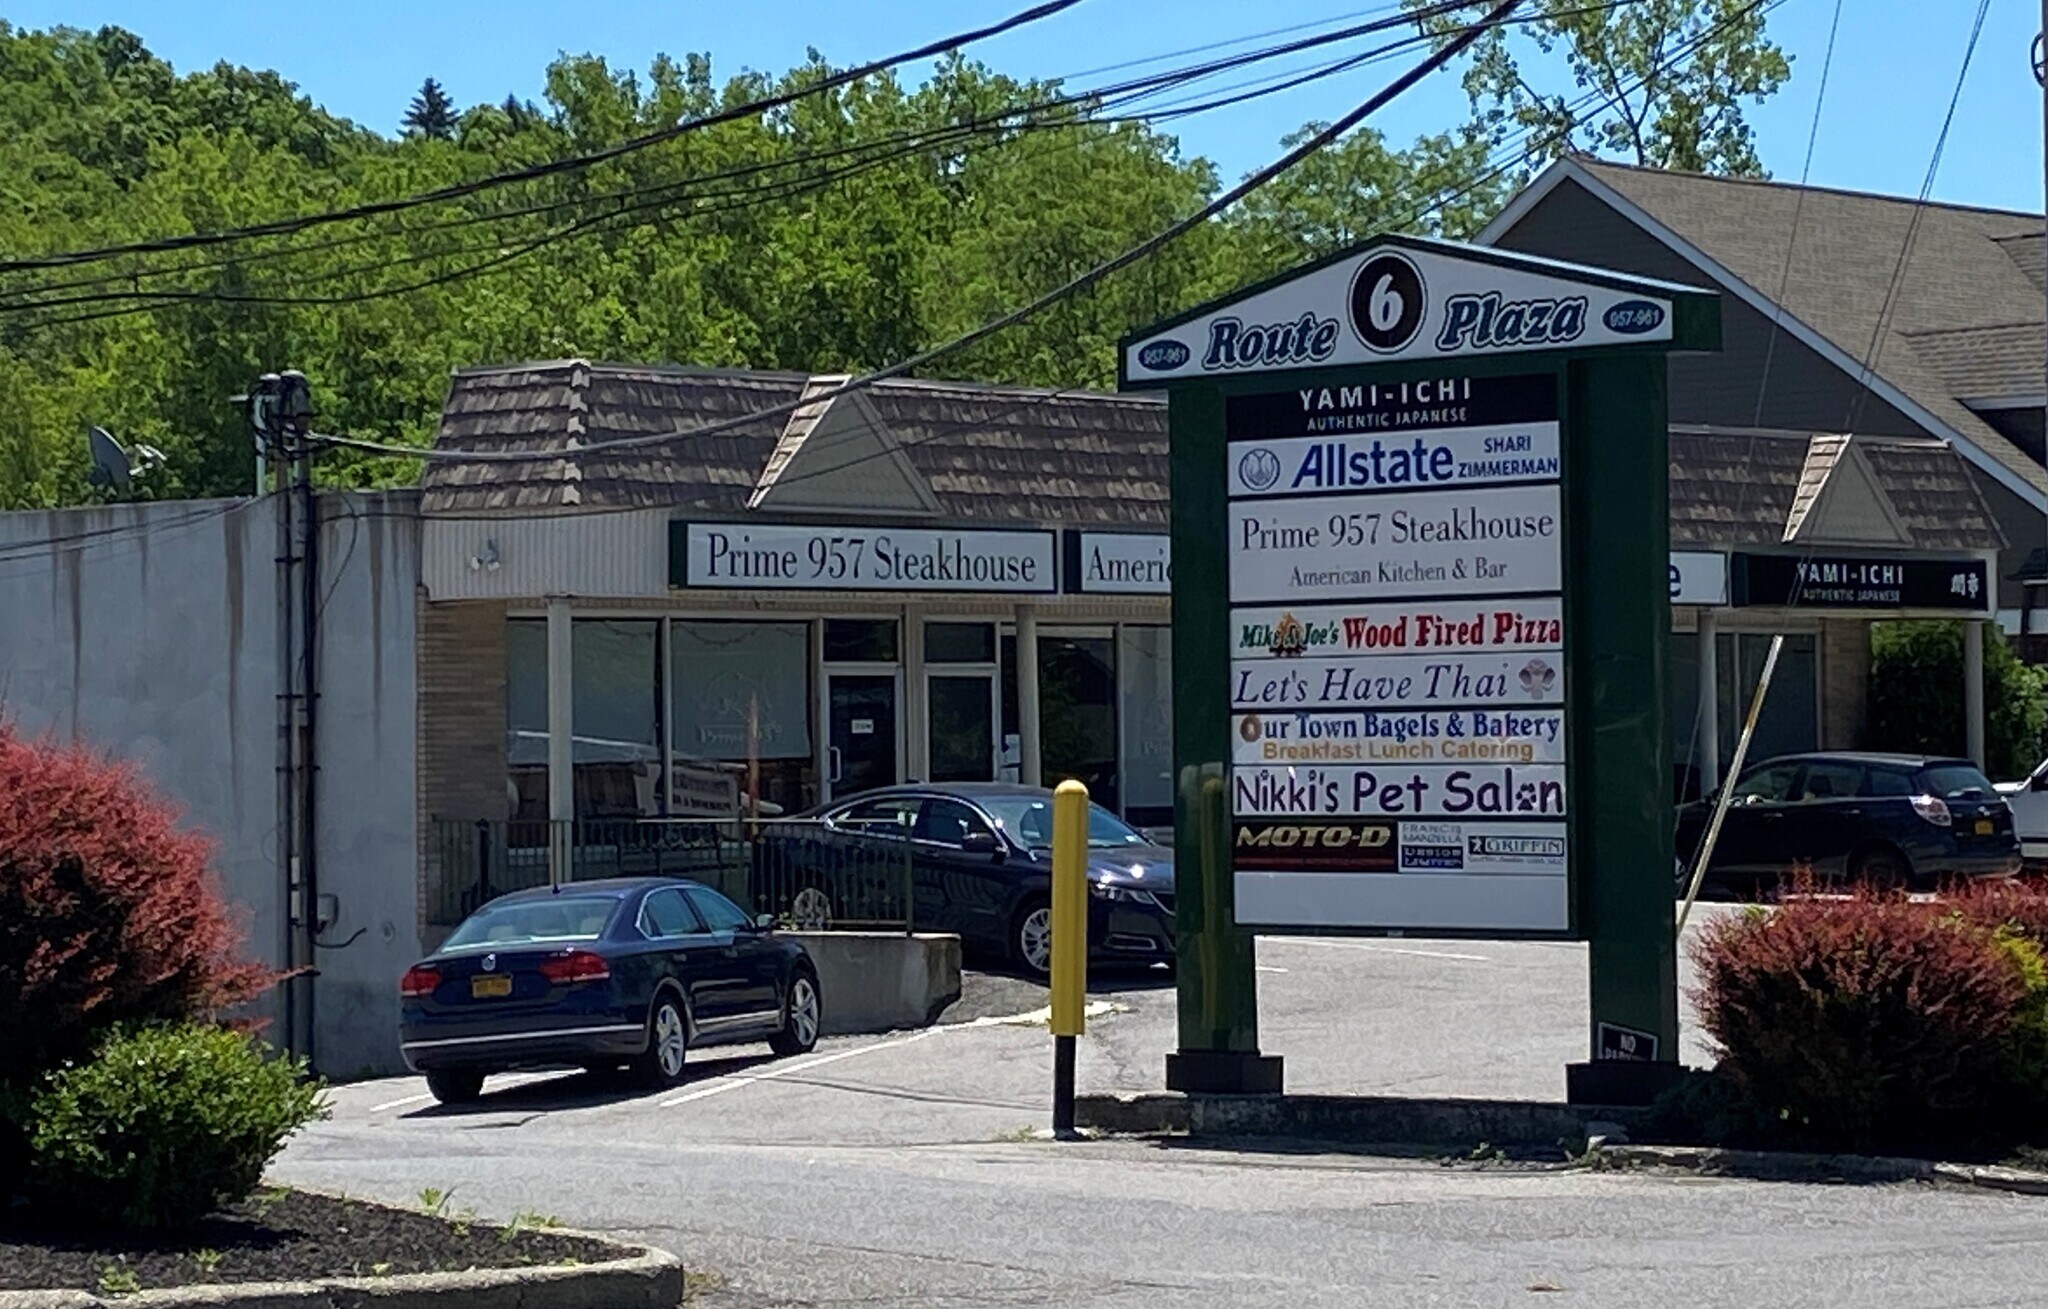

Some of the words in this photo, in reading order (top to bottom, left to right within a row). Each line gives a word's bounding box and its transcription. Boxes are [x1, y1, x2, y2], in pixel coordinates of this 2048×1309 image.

[1203, 318, 1339, 368] Route
[1369, 272, 1404, 331] 6
[1436, 293, 1587, 350] Plaza
[1609, 308, 1660, 328] 957-961
[1299, 377, 1472, 411] YAMI-ICHI
[1307, 411, 1390, 431] AUTHENTIC
[1395, 406, 1468, 425] JAPANESE
[1483, 435, 1531, 454] SHARI
[1291, 443, 1454, 488] Allstate
[1458, 456, 1558, 479] ZIMMERMAN
[1241, 516, 1320, 550] Prime
[1328, 514, 1380, 546] 957
[1391, 506, 1554, 543] Steakhouse
[706, 532, 798, 580] Prime
[807, 536, 866, 581] 957
[873, 535, 1037, 583] Steakhouse
[1289, 566, 1371, 587] American
[1377, 560, 1447, 583] Kitchen
[1452, 559, 1468, 580] &
[1474, 556, 1507, 578] Bar
[1797, 563, 1904, 584] YAMI-ICHI
[1239, 624, 1280, 648] Mike
[1302, 620, 1340, 646] Joe's
[1342, 615, 1408, 649] Wood
[1414, 613, 1485, 647] Fired
[1493, 612, 1562, 645] Pizza
[1236, 669, 1309, 702] Let's
[1319, 667, 1412, 701] Have
[1424, 662, 1509, 698] Thai
[1240, 712, 1290, 742] Our
[1295, 712, 1357, 739] Town
[1364, 711, 1440, 742] Bagels
[1446, 712, 1465, 737] &
[1473, 711, 1561, 742] Bakery
[1263, 741, 1362, 760] Breakfast
[1369, 741, 1434, 759] Lunch
[1441, 740, 1534, 761] Catering
[1236, 768, 1339, 813] Nikki's
[1352, 771, 1429, 813] Pet
[1236, 826, 1391, 847] MOTO-D
[1402, 823, 1462, 834] FRANCIS
[1487, 839, 1561, 853] GRIFFIN
